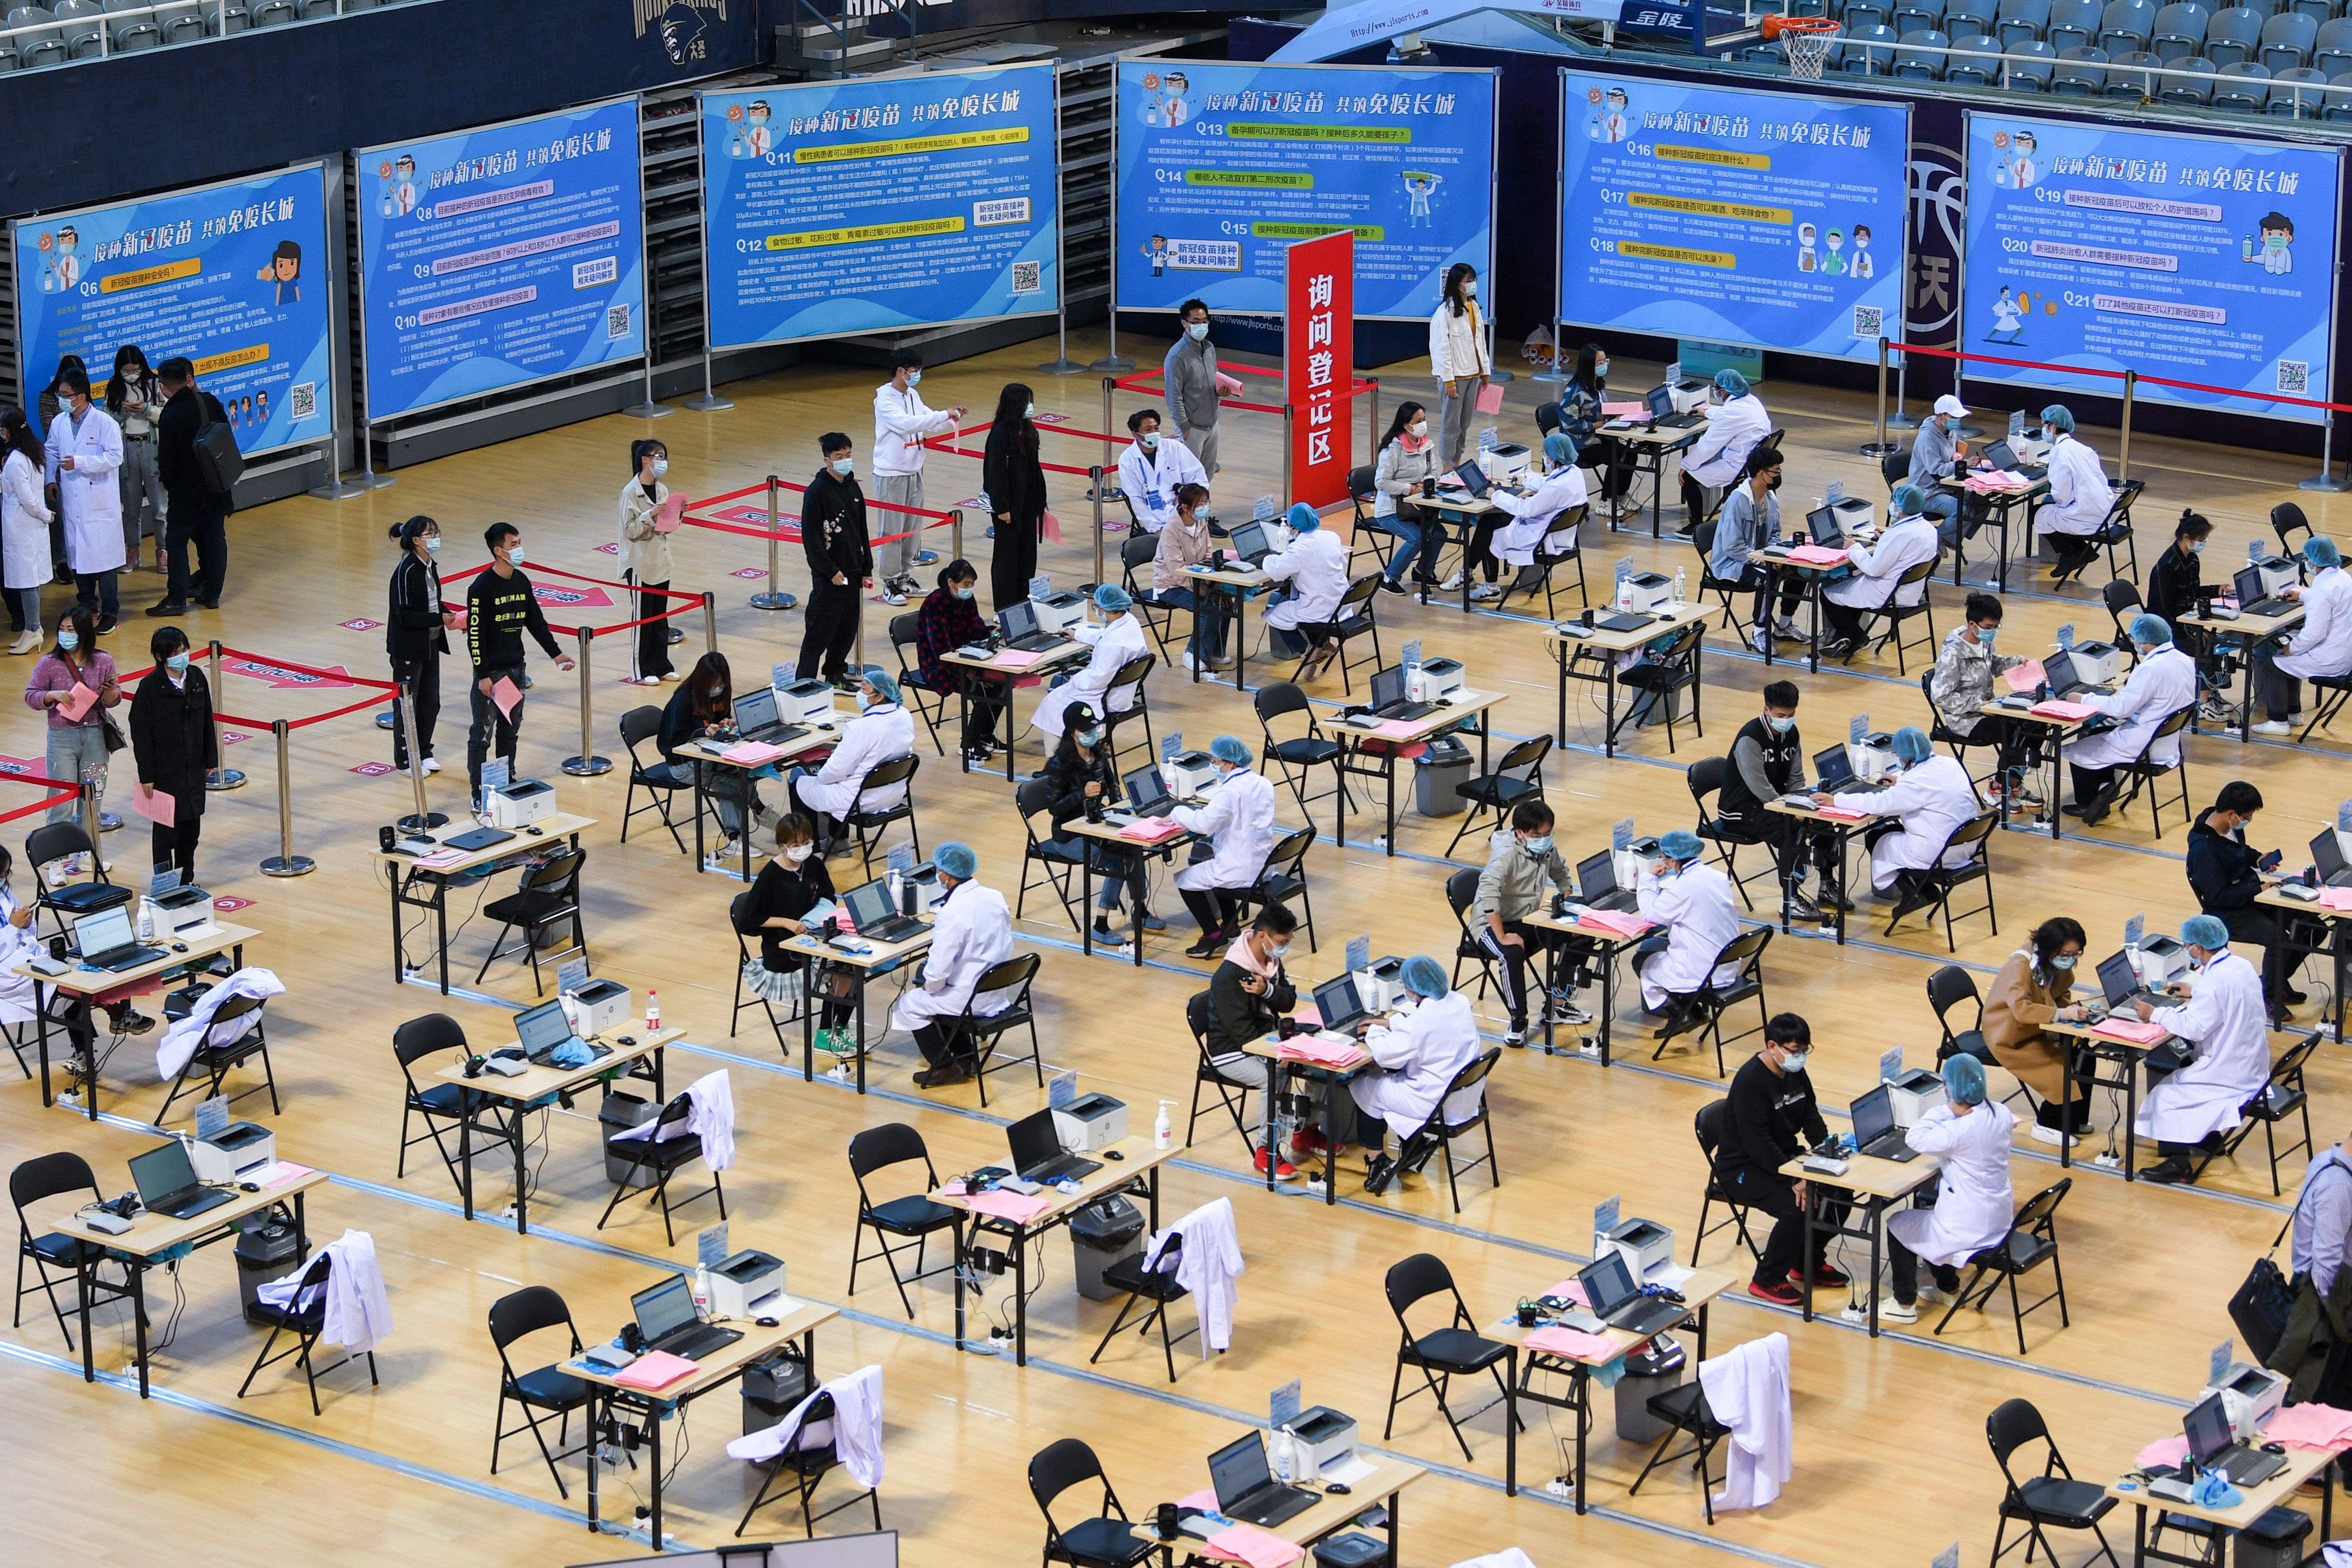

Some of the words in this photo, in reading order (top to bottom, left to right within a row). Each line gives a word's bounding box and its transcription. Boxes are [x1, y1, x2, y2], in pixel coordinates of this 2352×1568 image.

[690, 40, 706, 61] 大圣
[788, 103, 901, 135] 接种新冠疫苗
[911, 89, 1020, 122] 共筑免疫长城
[1205, 90, 1326, 113] 接种新冠疫苗
[1335, 93, 1456, 115] 共筑免疫长城
[1196, 121, 1223, 135] Q13
[1232, 126, 1404, 139] 备孕期可以打新冠疫苗吗？接种后多久能要孩子？
[1643, 110, 1750, 138] 接种新冠疫苗
[1759, 121, 1871, 148] 共筑免疫长城
[429, 149, 518, 190] 接种新冠疫苗
[525, 127, 611, 168] 共筑免疫长城
[763, 149, 790, 166] Q11
[1627, 141, 1651, 156] Q16
[1658, 148, 1749, 165] 接种新冠疫苗时应注意什么？
[1155, 168, 1182, 183] Q14
[1194, 173, 1303, 184] 哪些人不适宜打第二剂次疫苗？
[2051, 155, 2169, 183] 接种新冠疫苗
[2178, 167, 2299, 195] 共筑免疫长城
[416, 207, 432, 222] Q8
[438, 184, 548, 215] 目前接种的新冠疫苗是否对变异病毒有效？
[979, 200, 1025, 213] 新冠疫苗接种
[1601, 188, 1627, 203] Q17
[1633, 196, 1774, 219] 接种完新冠疫苗是否可以喝酒、吃辛辣食物？
[2034, 187, 2061, 203] Q19
[2069, 194, 2214, 217] 接种新冠疫苗后可以放松个人防护措施吗？
[979, 210, 1025, 223] 相关疑问解答
[1221, 221, 1248, 235] Q15
[94, 219, 193, 263] 接种新冠疫苗
[201, 196, 294, 239] 共筑免疫长城
[736, 239, 762, 253] Q12
[772, 220, 956, 247] 食物过敏、花粉过敏、青霉素过敏可以接种新冠疫苗吗？
[1176, 243, 1240, 257] 新冠疫苗接种
[1176, 253, 1240, 268] 相关疑问解答
[1590, 237, 1614, 252] Q18
[1625, 245, 1722, 263] 接种完新冠疫苗是否可以洗澡？
[2002, 237, 2028, 253] Q20
[2036, 244, 2172, 267] 新冠肺炎治愈人群需要接种新冠疫苗吗？
[414, 264, 429, 279] Q9
[577, 259, 613, 276] 新冠疫苗接种
[578, 270, 613, 285] 相关疑问解答
[80, 281, 98, 297] Q6
[111, 267, 175, 288] 新冠疫苗接种安全吗？
[395, 315, 416, 330] Q10
[422, 289, 533, 322] 接种对象有哪些情况应暂缓接种新冠疫苗？
[2064, 291, 2089, 307] Q21
[2098, 299, 2220, 320] 打了其他疫苗还可以打新冠疫苗吗？
[1307, 274, 1334, 466] 询问登记区
[471, 597, 481, 666] REQUIRED
[187, 987, 207, 997] PUSH
[263, 1225, 285, 1236] PUSH
[771, 1362, 794, 1376] PUSH
